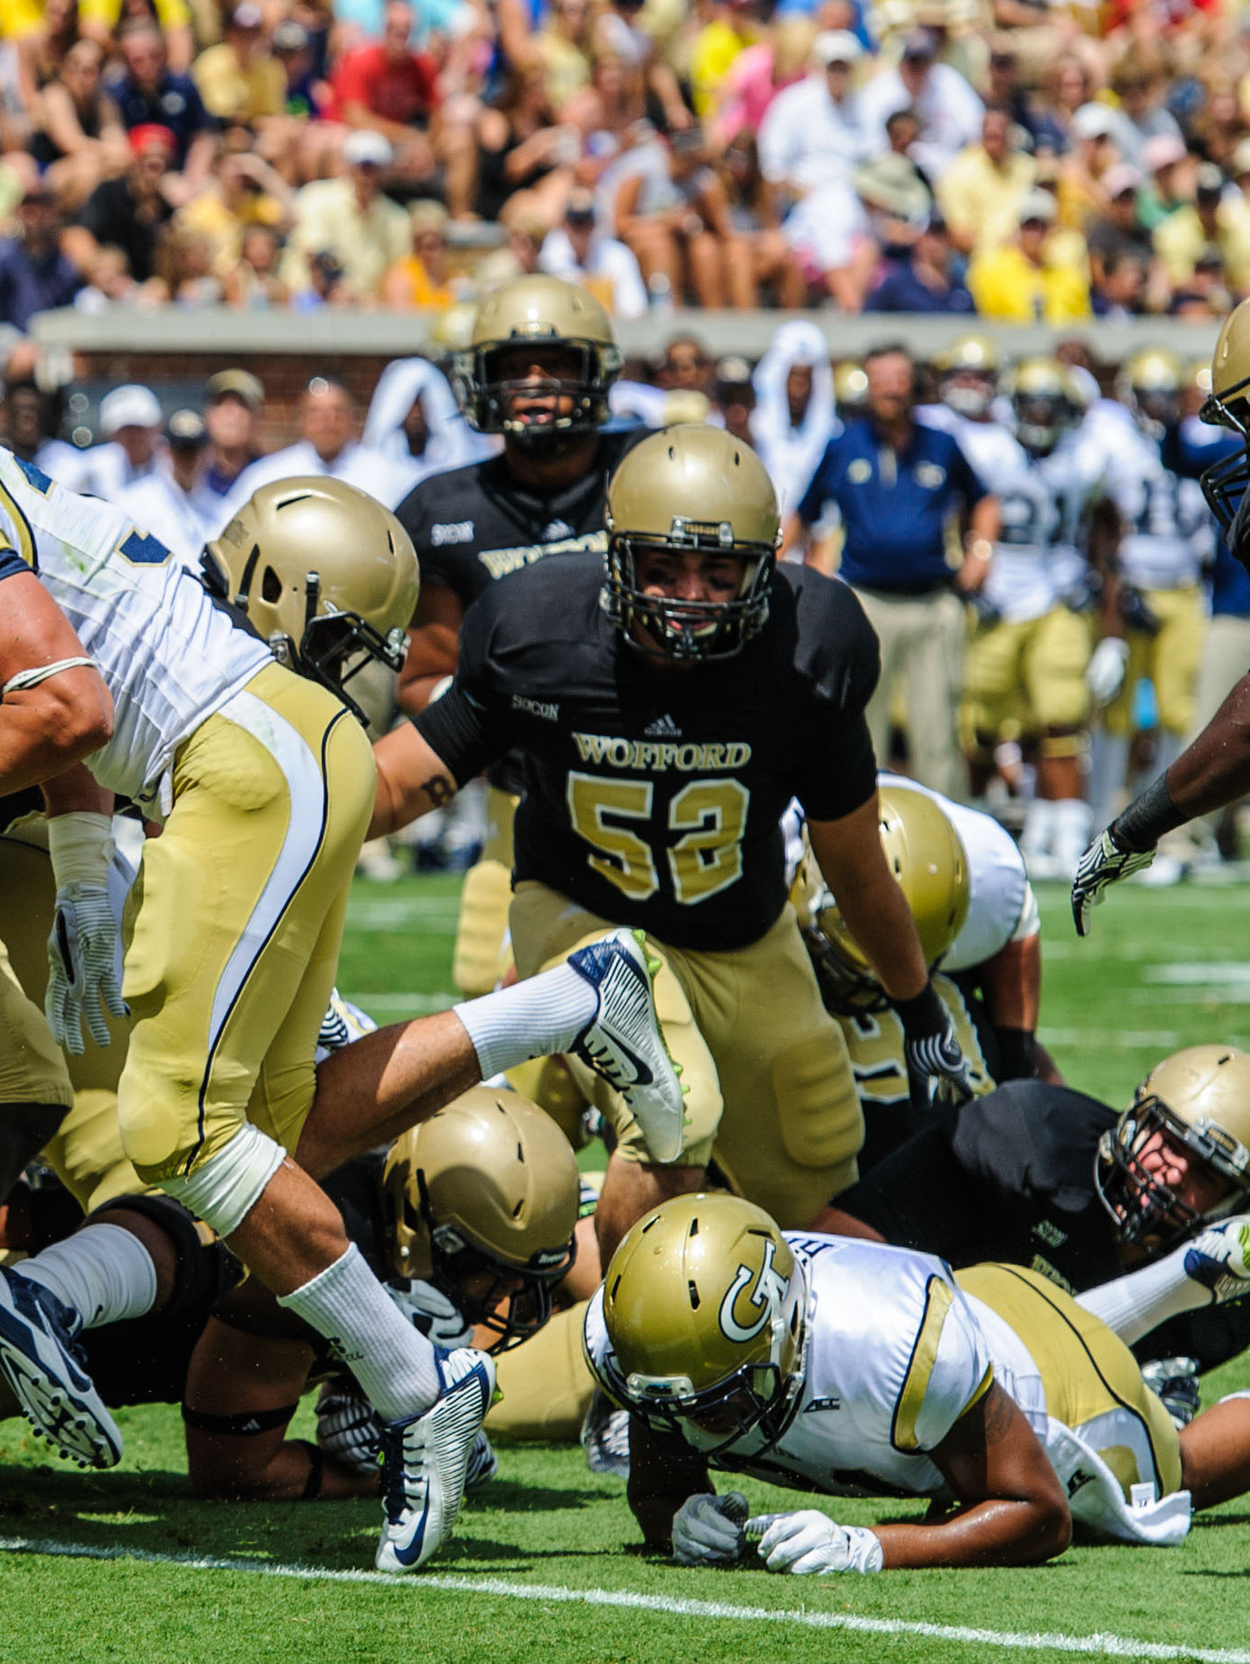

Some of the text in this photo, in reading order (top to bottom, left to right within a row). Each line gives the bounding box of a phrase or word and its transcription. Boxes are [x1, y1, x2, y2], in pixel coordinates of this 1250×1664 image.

[511, 694, 559, 721] SOCON
[571, 732, 752, 771] WOFFORD
[567, 770, 750, 905] 52
[803, 1397, 841, 1414] ACC
